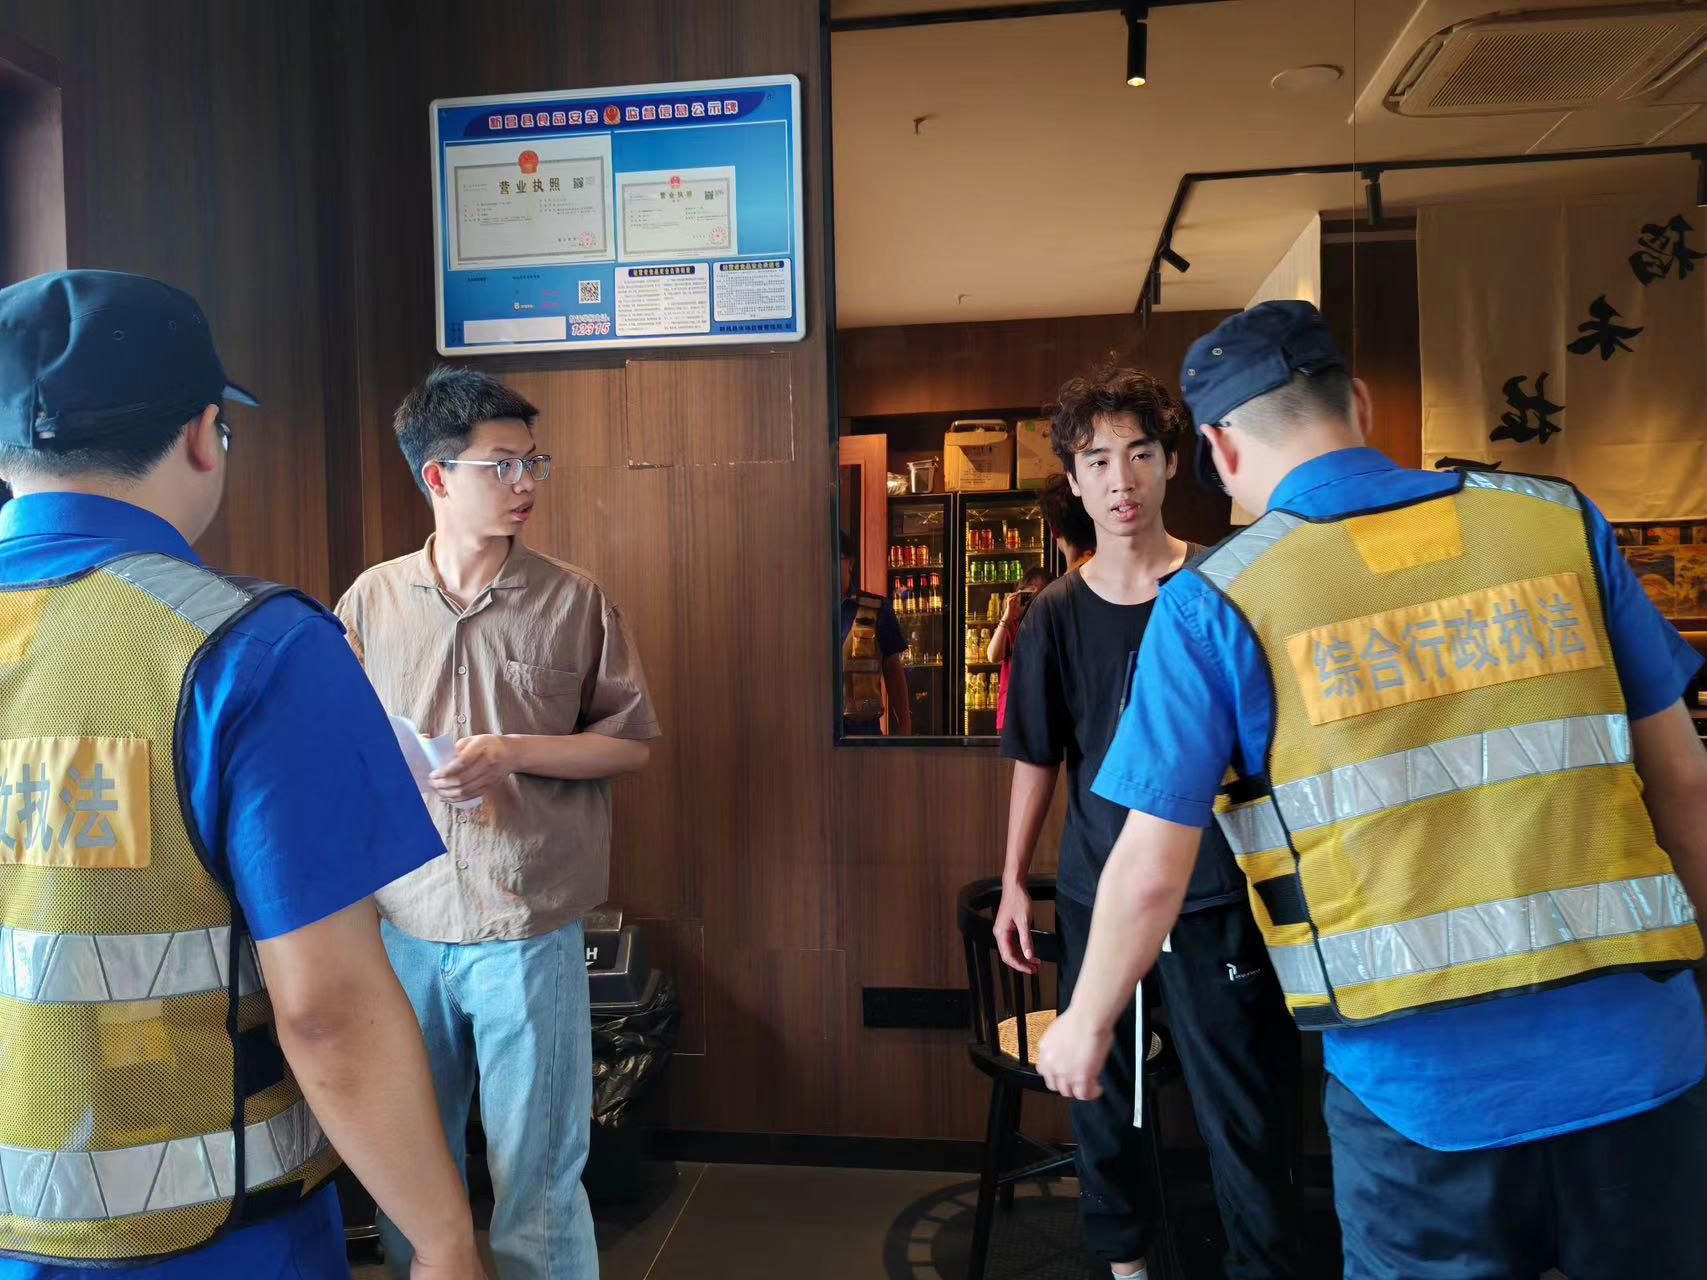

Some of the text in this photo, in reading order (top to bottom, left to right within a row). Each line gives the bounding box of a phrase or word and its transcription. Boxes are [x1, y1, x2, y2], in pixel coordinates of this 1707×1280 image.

[625, 100, 739, 121] 监督信息公示牌
[499, 177, 561, 195] 营业执照
[571, 322, 611, 338] 12315
[1313, 592, 1586, 699] 综合行政执法
